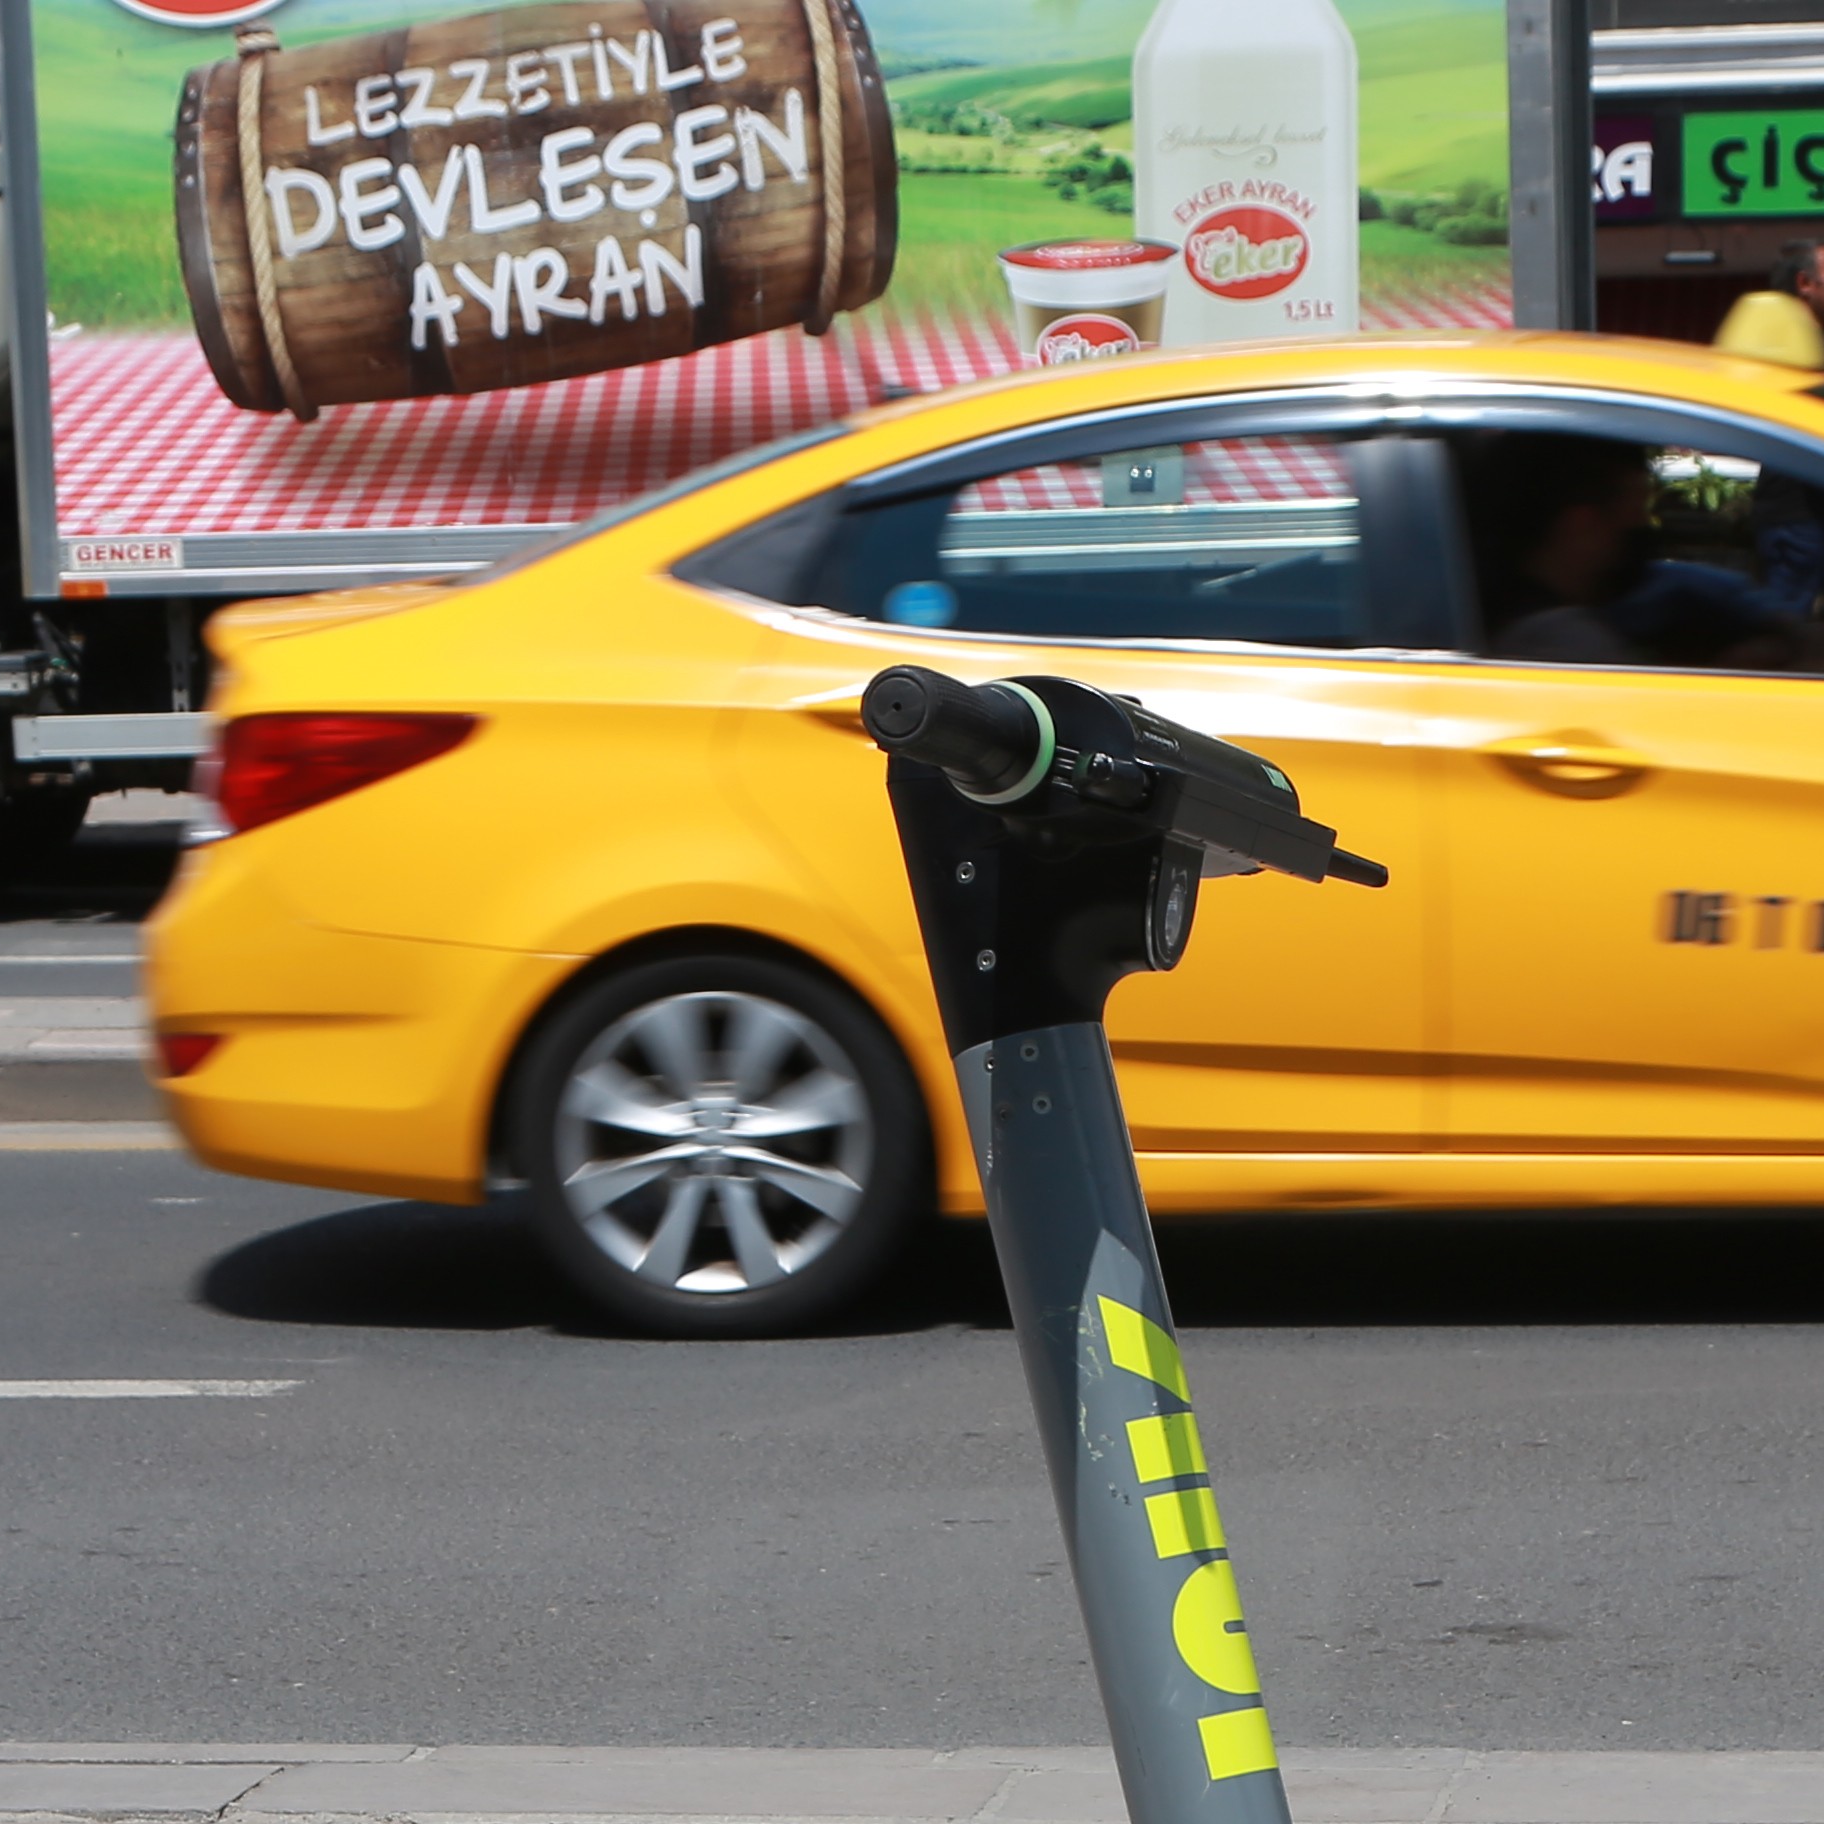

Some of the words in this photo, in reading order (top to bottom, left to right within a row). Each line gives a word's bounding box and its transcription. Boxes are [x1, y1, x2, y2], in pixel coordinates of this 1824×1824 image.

[305, 18, 747, 146] LEZZETİYLE
[264, 88, 809, 258] DEVLEŞEN
[1173, 180, 1235, 226] EKER
[1240, 178, 1318, 219] AYRAN
[409, 224, 704, 349] AYRAN
